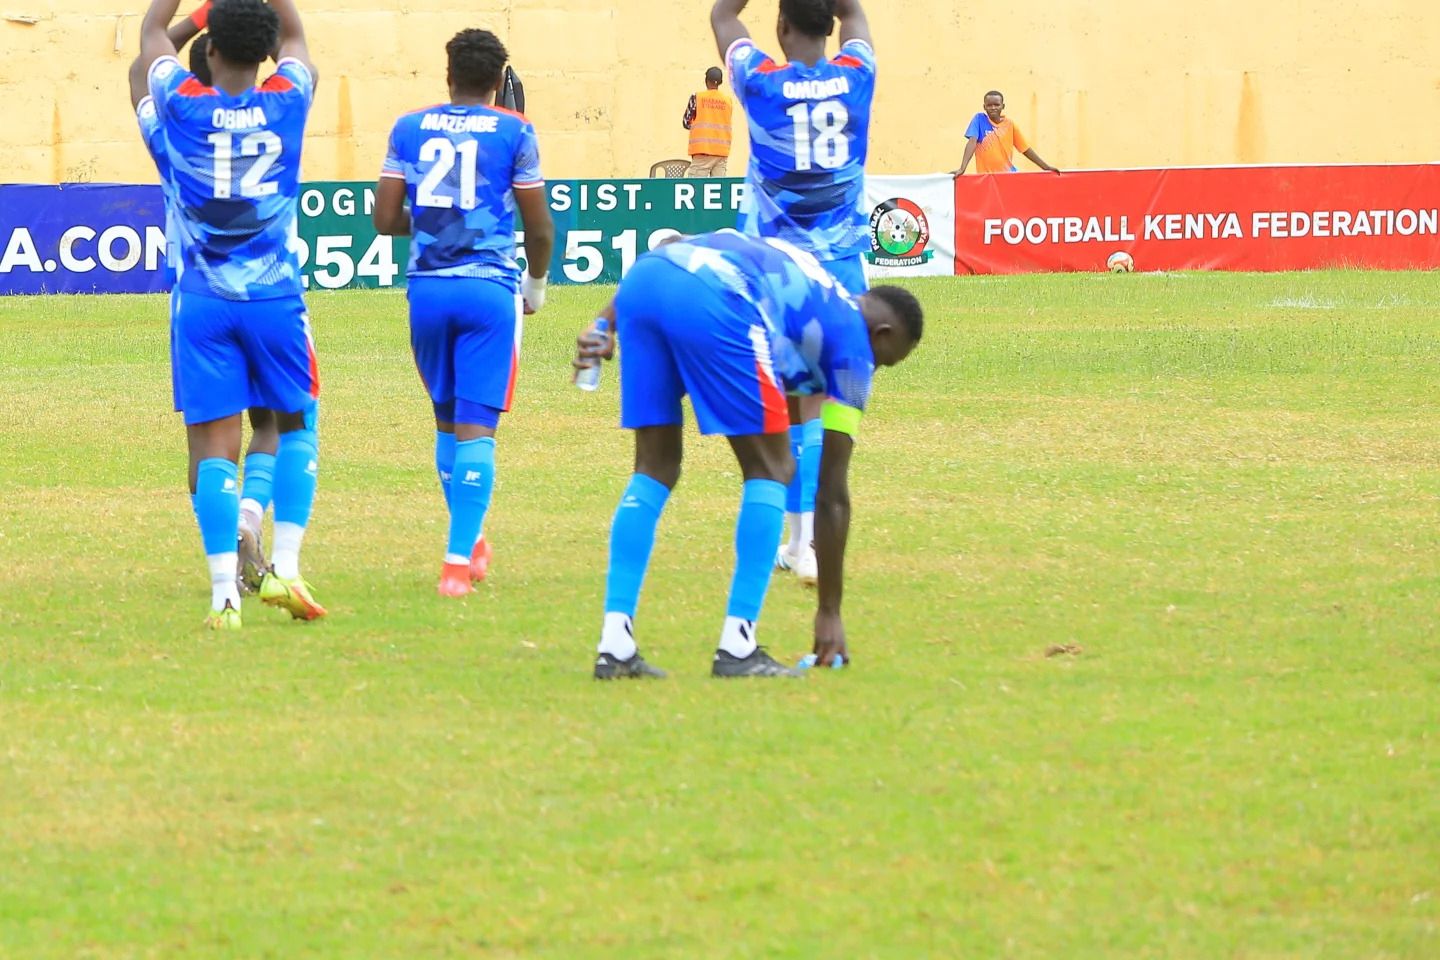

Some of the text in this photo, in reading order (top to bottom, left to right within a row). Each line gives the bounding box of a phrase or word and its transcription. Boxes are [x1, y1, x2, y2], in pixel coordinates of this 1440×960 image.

[212, 106, 267, 129] OBINA
[420, 113, 500, 133] MAZEMBE
[786, 99, 850, 171] 18
[207, 130, 283, 200] 12
[416, 137, 479, 210] 21
[300, 188, 376, 217] OGN
[550, 183, 653, 212] SIST.
[870, 207, 885, 251] FOOTBALL
[916, 214, 927, 244] KENYA
[984, 209, 1439, 245] FOOTBALL KENYA FEDERATION
[875, 256, 923, 266] FEDERATION
